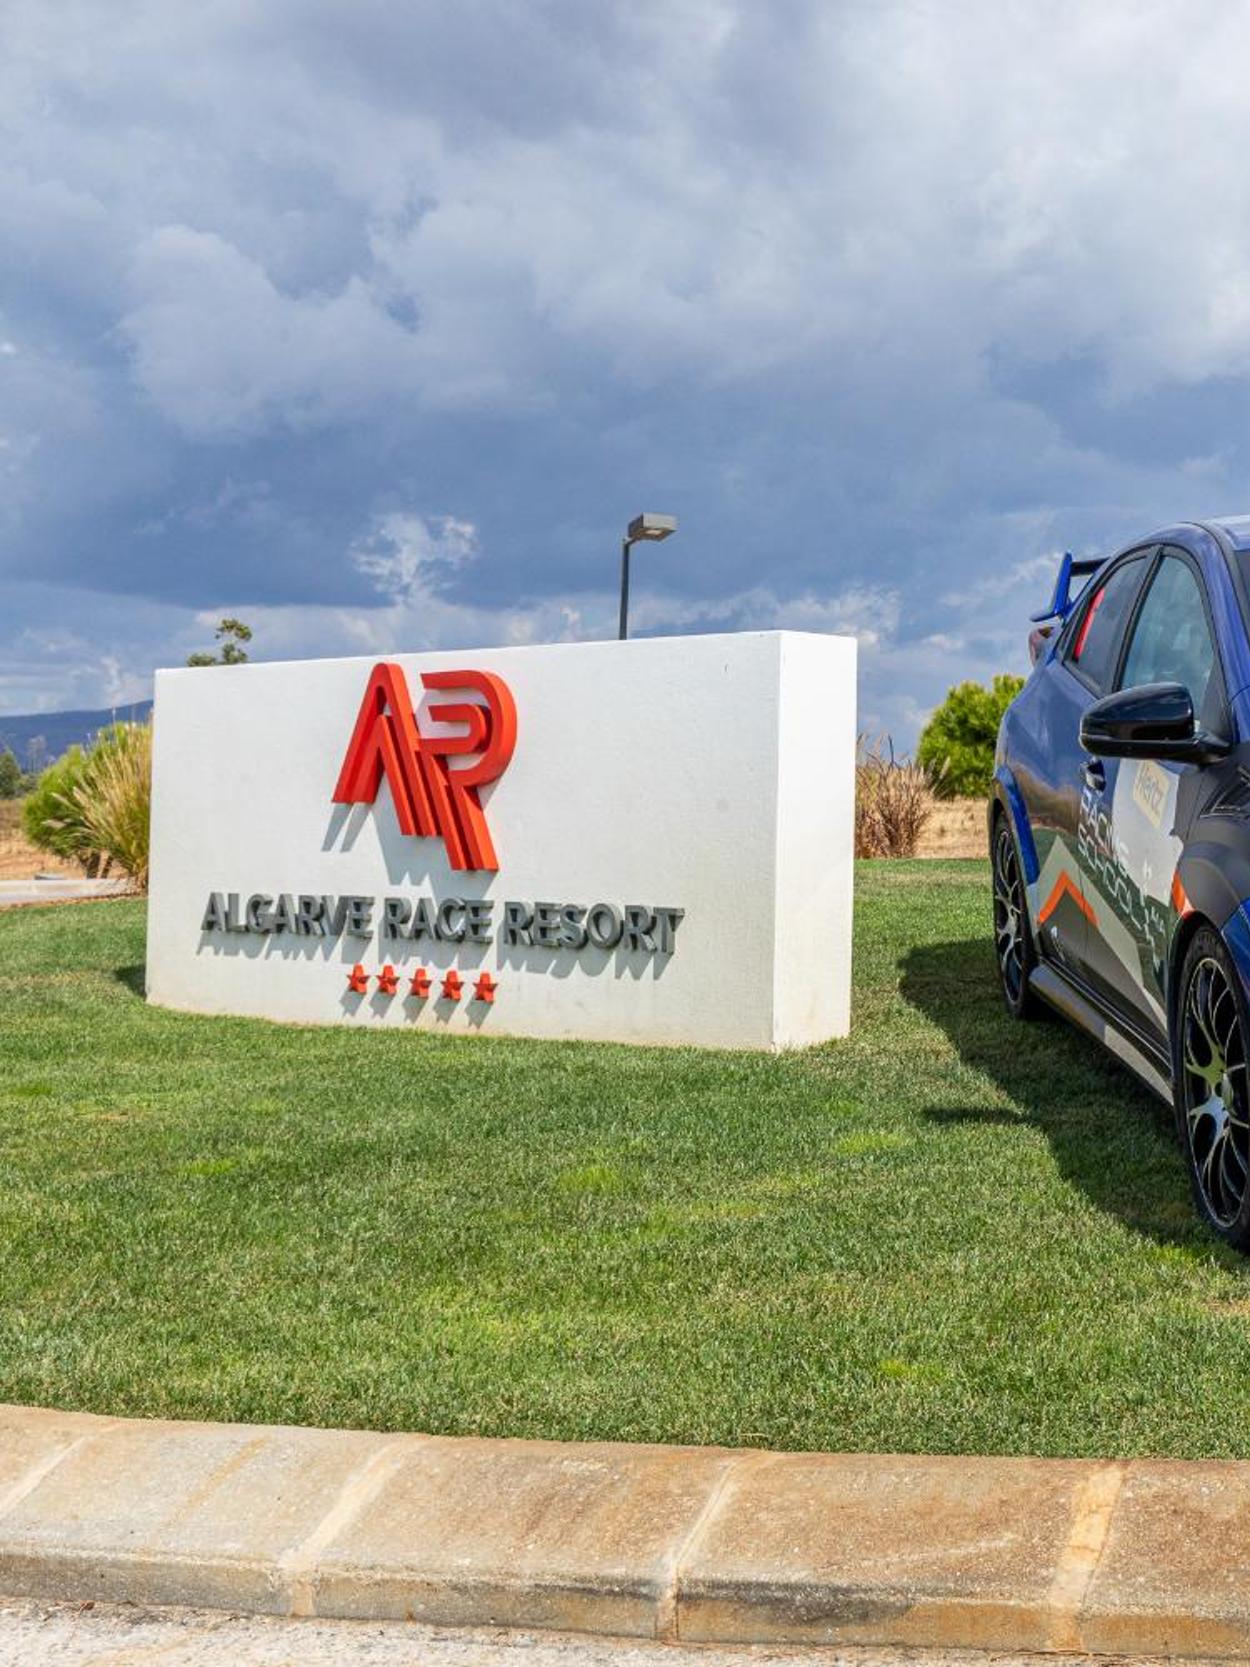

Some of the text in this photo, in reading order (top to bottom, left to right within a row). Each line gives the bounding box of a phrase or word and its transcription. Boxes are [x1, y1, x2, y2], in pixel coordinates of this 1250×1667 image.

[201, 892, 685, 953] ALGARVE RACE RESORT
